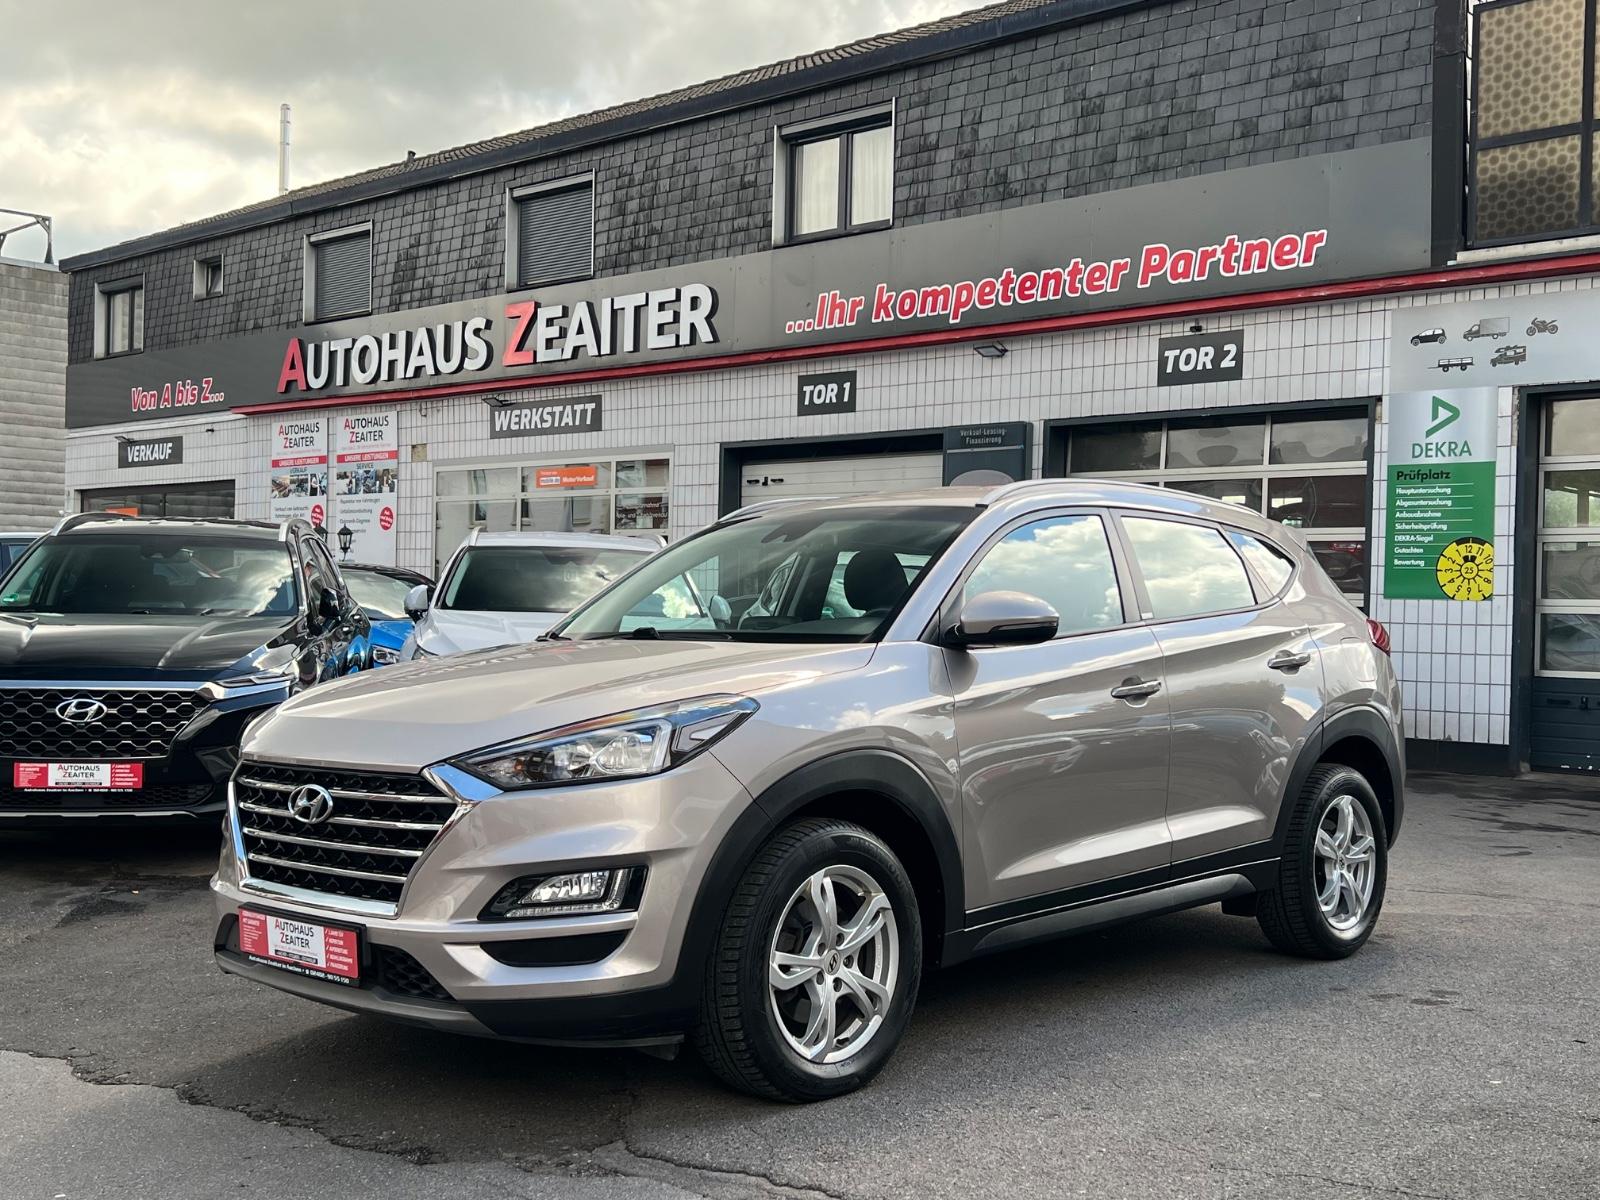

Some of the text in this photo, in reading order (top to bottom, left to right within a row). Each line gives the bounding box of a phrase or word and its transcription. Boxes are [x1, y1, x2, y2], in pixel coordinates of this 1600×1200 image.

[785, 229, 1328, 335] ...Ihr kompetenter Partner
[277, 283, 718, 394] AUTOHAUS ZEAITER
[1163, 344, 1238, 375] TOR 2
[131, 377, 225, 412] Von A bis Z...
[801, 381, 852, 406] TOR 1
[344, 415, 389, 430] AUTOHAUS
[494, 402, 596, 433] WERKSTATT
[278, 422, 320, 436] AUTOHAUS
[283, 436, 315, 449] ZEAITER
[349, 430, 383, 443] ZEAITER
[127, 442, 173, 463] VERKAUF
[1411, 440, 1472, 459] DEKRA
[1396, 469, 1451, 482] Prüfplatz
[1395, 486, 1452, 495] Hauptuntersuchung
[1395, 498, 1452, 508] Abgasuntersuchung
[1395, 510, 1441, 518] Anbauabnahme
[1395, 522, 1448, 531] Sicherheitsprüfung
[1394, 534, 1434, 544] DEKRA-Siegel
[1465, 545, 1473, 554] 12
[1394, 558, 1425, 567] Bewertung
[57, 764, 100, 772] AUTOHAUS
[275, 919, 314, 938] AUTOHAUS
[280, 932, 310, 949] ZEAITER
